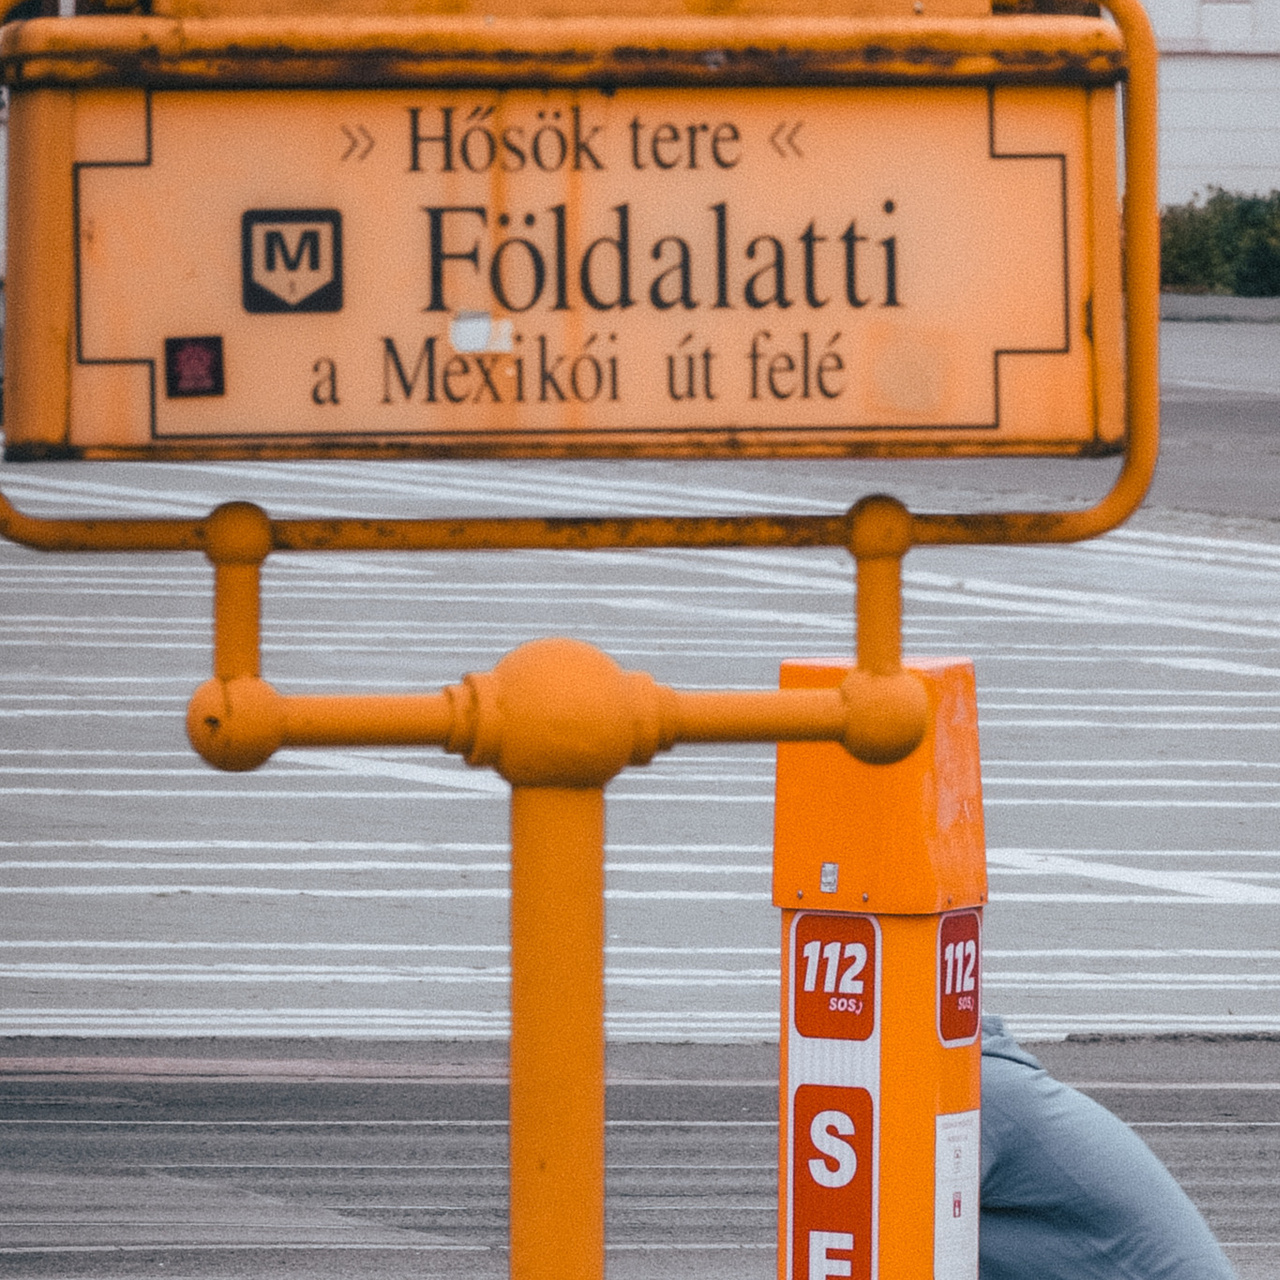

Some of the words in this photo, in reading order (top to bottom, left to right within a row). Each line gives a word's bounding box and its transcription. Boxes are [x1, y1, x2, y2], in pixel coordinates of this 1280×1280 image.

[407, 106, 604, 172] Hősök
[629, 113, 742, 170] tere
[422, 200, 902, 311] Földalatti
[311, 355, 340, 405] a
[380, 332, 621, 403] Mexikói
[667, 333, 717, 399] út
[747, 330, 846, 400] felé
[803, 940, 867, 994] 112
[945, 940, 976, 994] 112
[829, 997, 857, 1012] SOS
